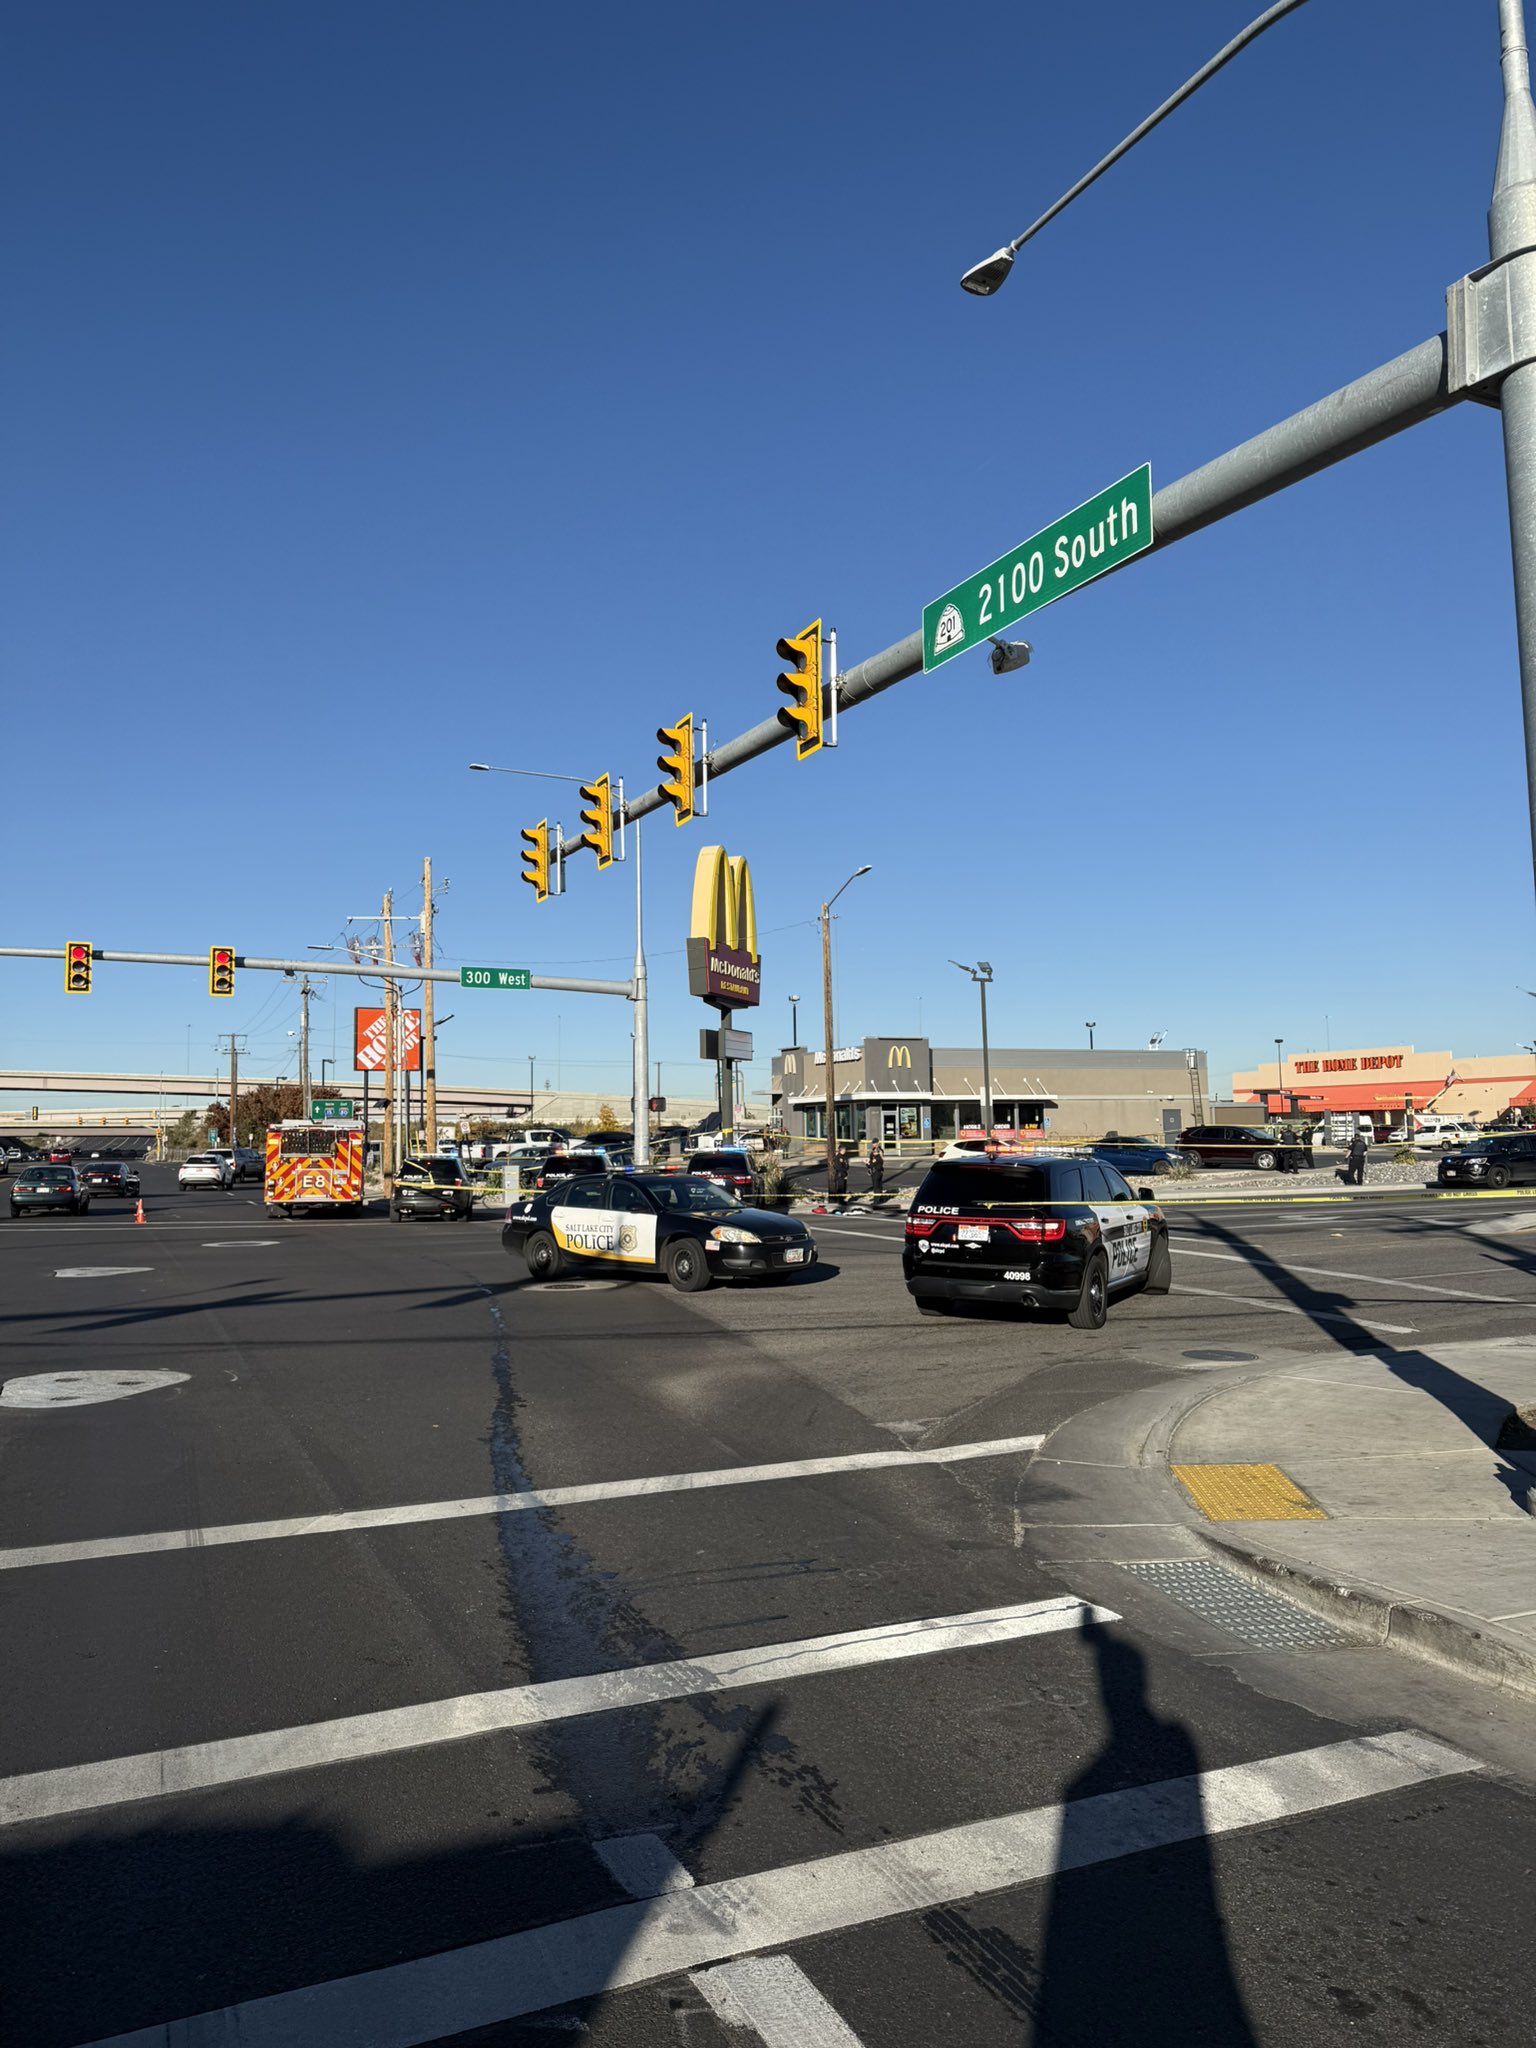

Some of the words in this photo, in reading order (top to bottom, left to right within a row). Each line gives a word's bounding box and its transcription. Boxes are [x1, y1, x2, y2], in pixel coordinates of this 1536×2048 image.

[978, 551, 1044, 625] 2100
[1054, 497, 1138, 578] South
[940, 616, 956, 637] 201
[466, 971, 491, 984] 300
[498, 972, 526, 985] West
[710, 956, 760, 984] McDonald's
[1295, 1061, 1319, 1074] THE
[1322, 1058, 1357, 1072] HOME
[1360, 1055, 1404, 1070] DEPOT
[302, 1176, 326, 1188] E8
[918, 1206, 960, 1215] POLICE
[566, 1224, 580, 1232] SALT
[566, 1234, 614, 1250] POLICE
[1112, 1237, 1139, 1270] POLICE
[1004, 1271, 1031, 1281] 40998
